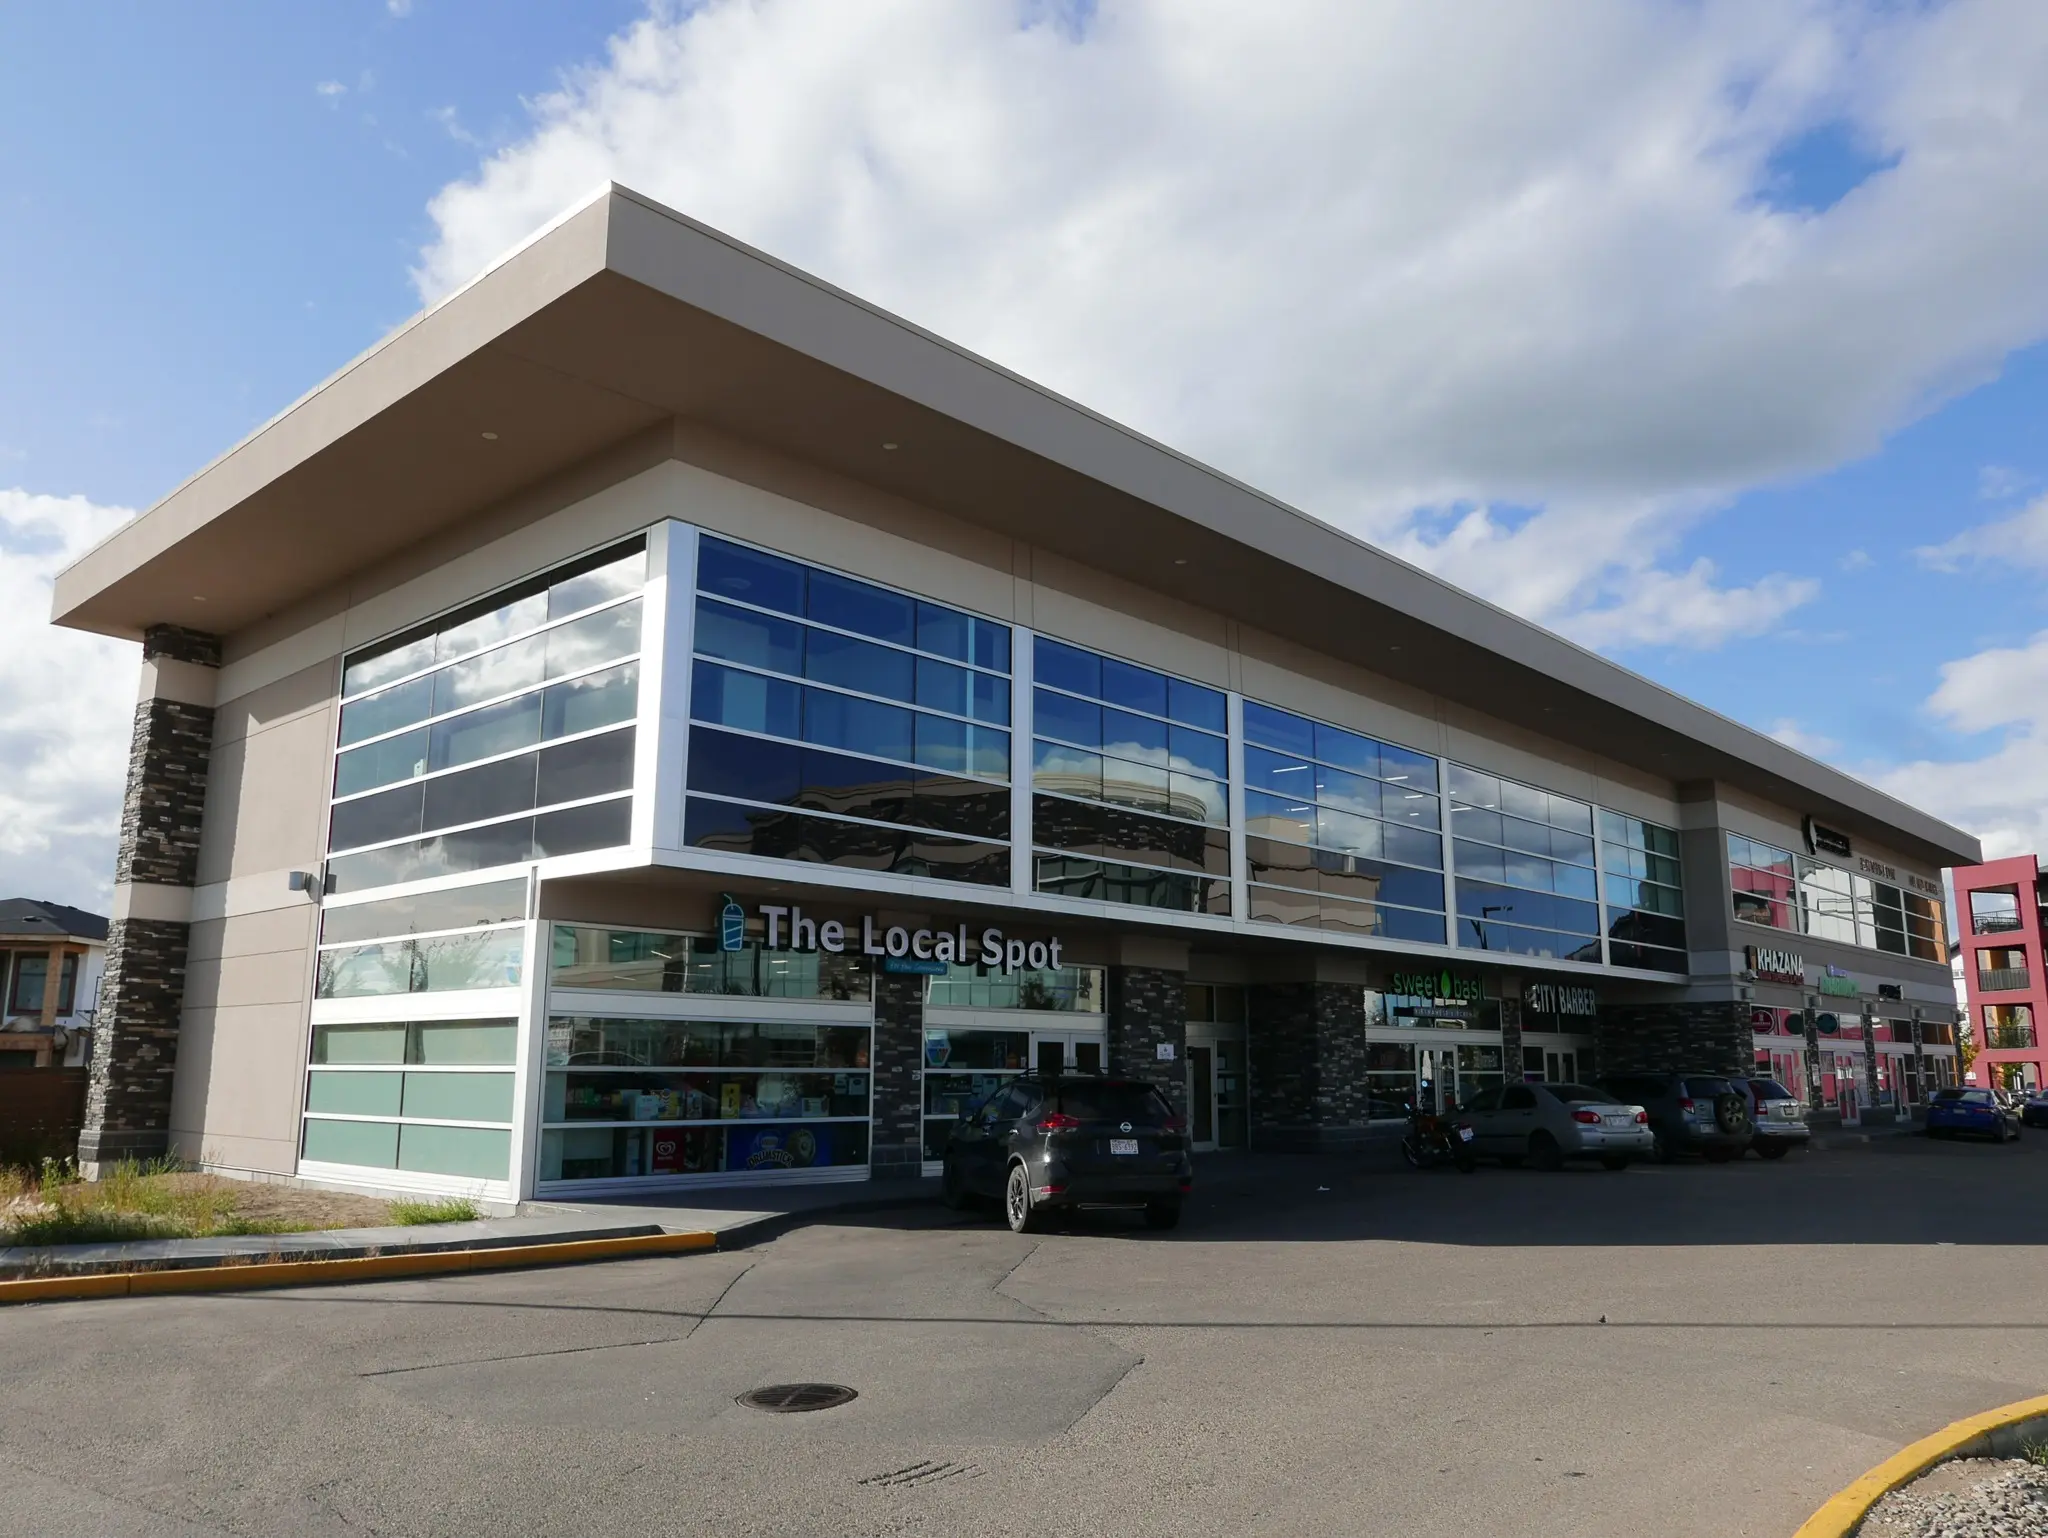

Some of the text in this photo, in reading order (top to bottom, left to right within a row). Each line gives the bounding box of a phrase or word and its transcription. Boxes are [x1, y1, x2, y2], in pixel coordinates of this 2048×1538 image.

[759, 904, 1063, 975] The Local Spot
[1757, 948, 1803, 976] KHAZANA
[1393, 972, 1487, 1000] sweet basil
[1535, 983, 1597, 1016] CITY BARBER
[747, 1150, 793, 1169] DRUMSTICK
